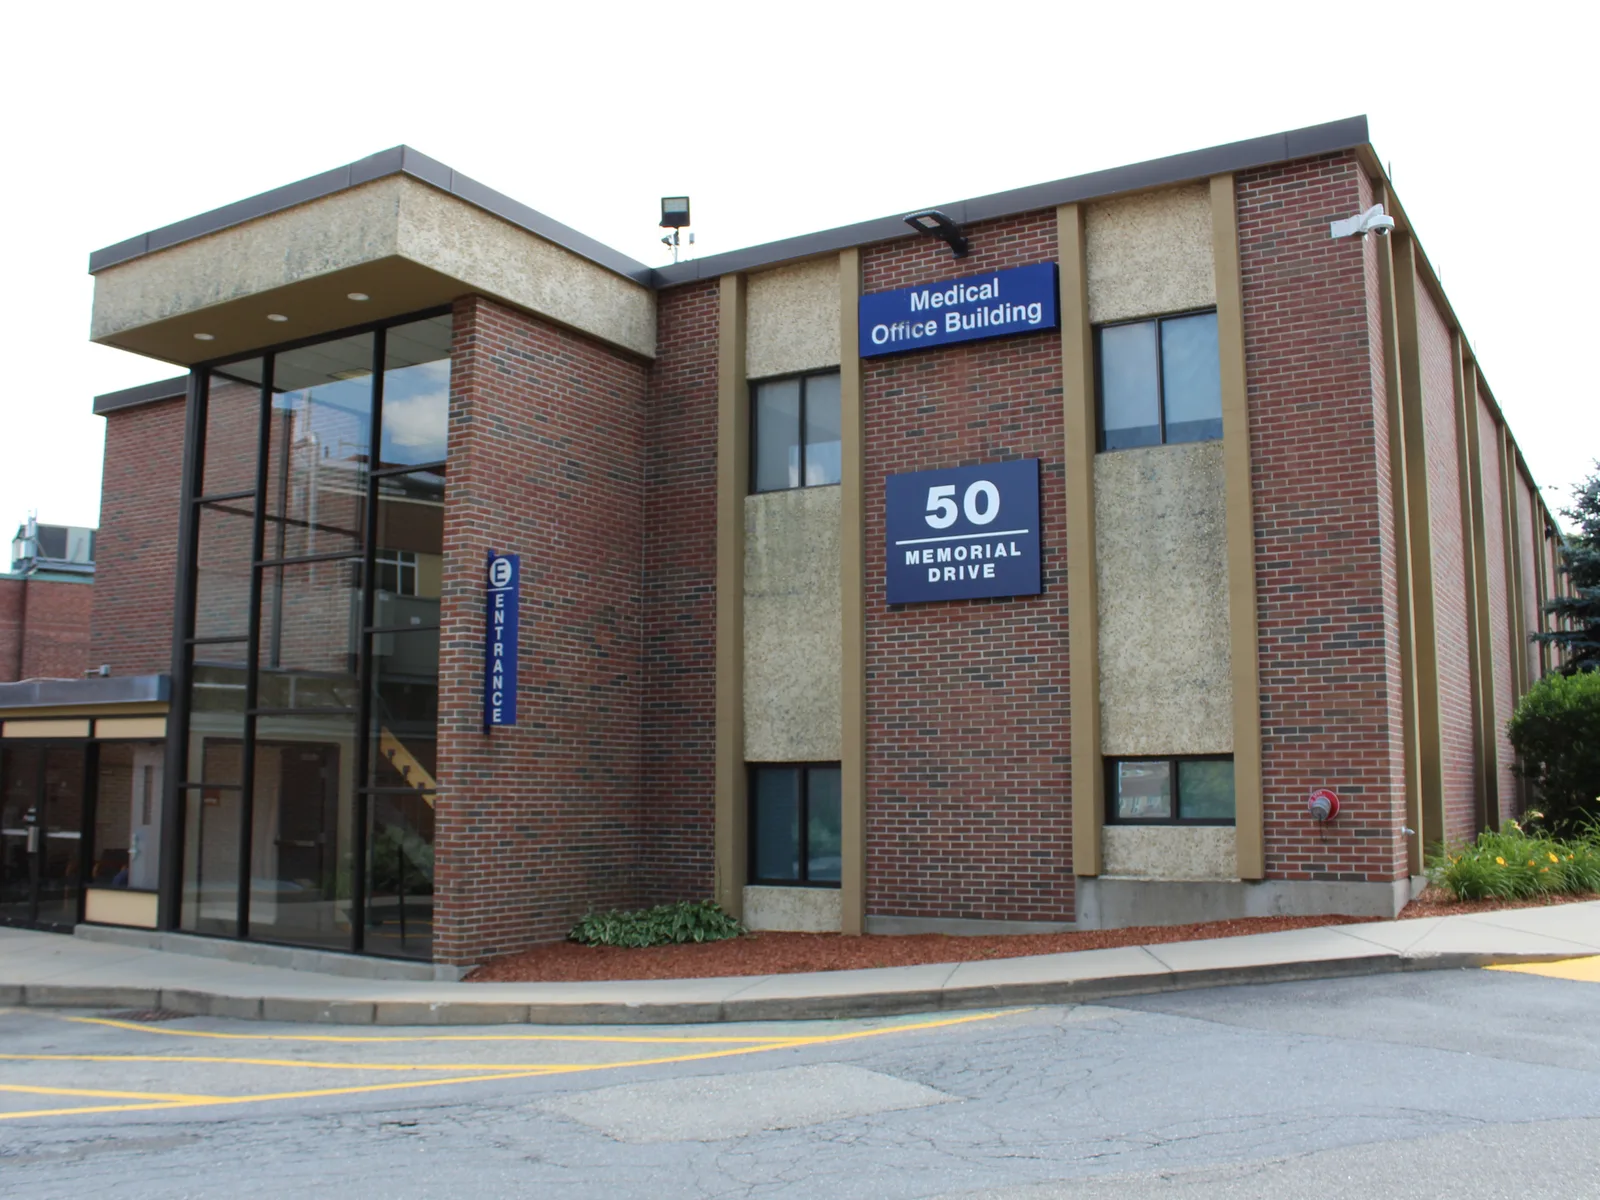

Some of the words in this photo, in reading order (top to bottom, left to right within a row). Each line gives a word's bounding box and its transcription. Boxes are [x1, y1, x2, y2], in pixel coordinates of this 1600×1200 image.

[910, 277, 999, 312] Medical
[871, 320, 938, 345] Office
[945, 302, 1042, 333] Building
[924, 480, 1001, 530] 50
[905, 541, 1022, 566] MEMORIAL
[493, 562, 507, 583] E
[928, 563, 996, 583] DRIVE
[492, 594, 505, 723] ENTRANCE
